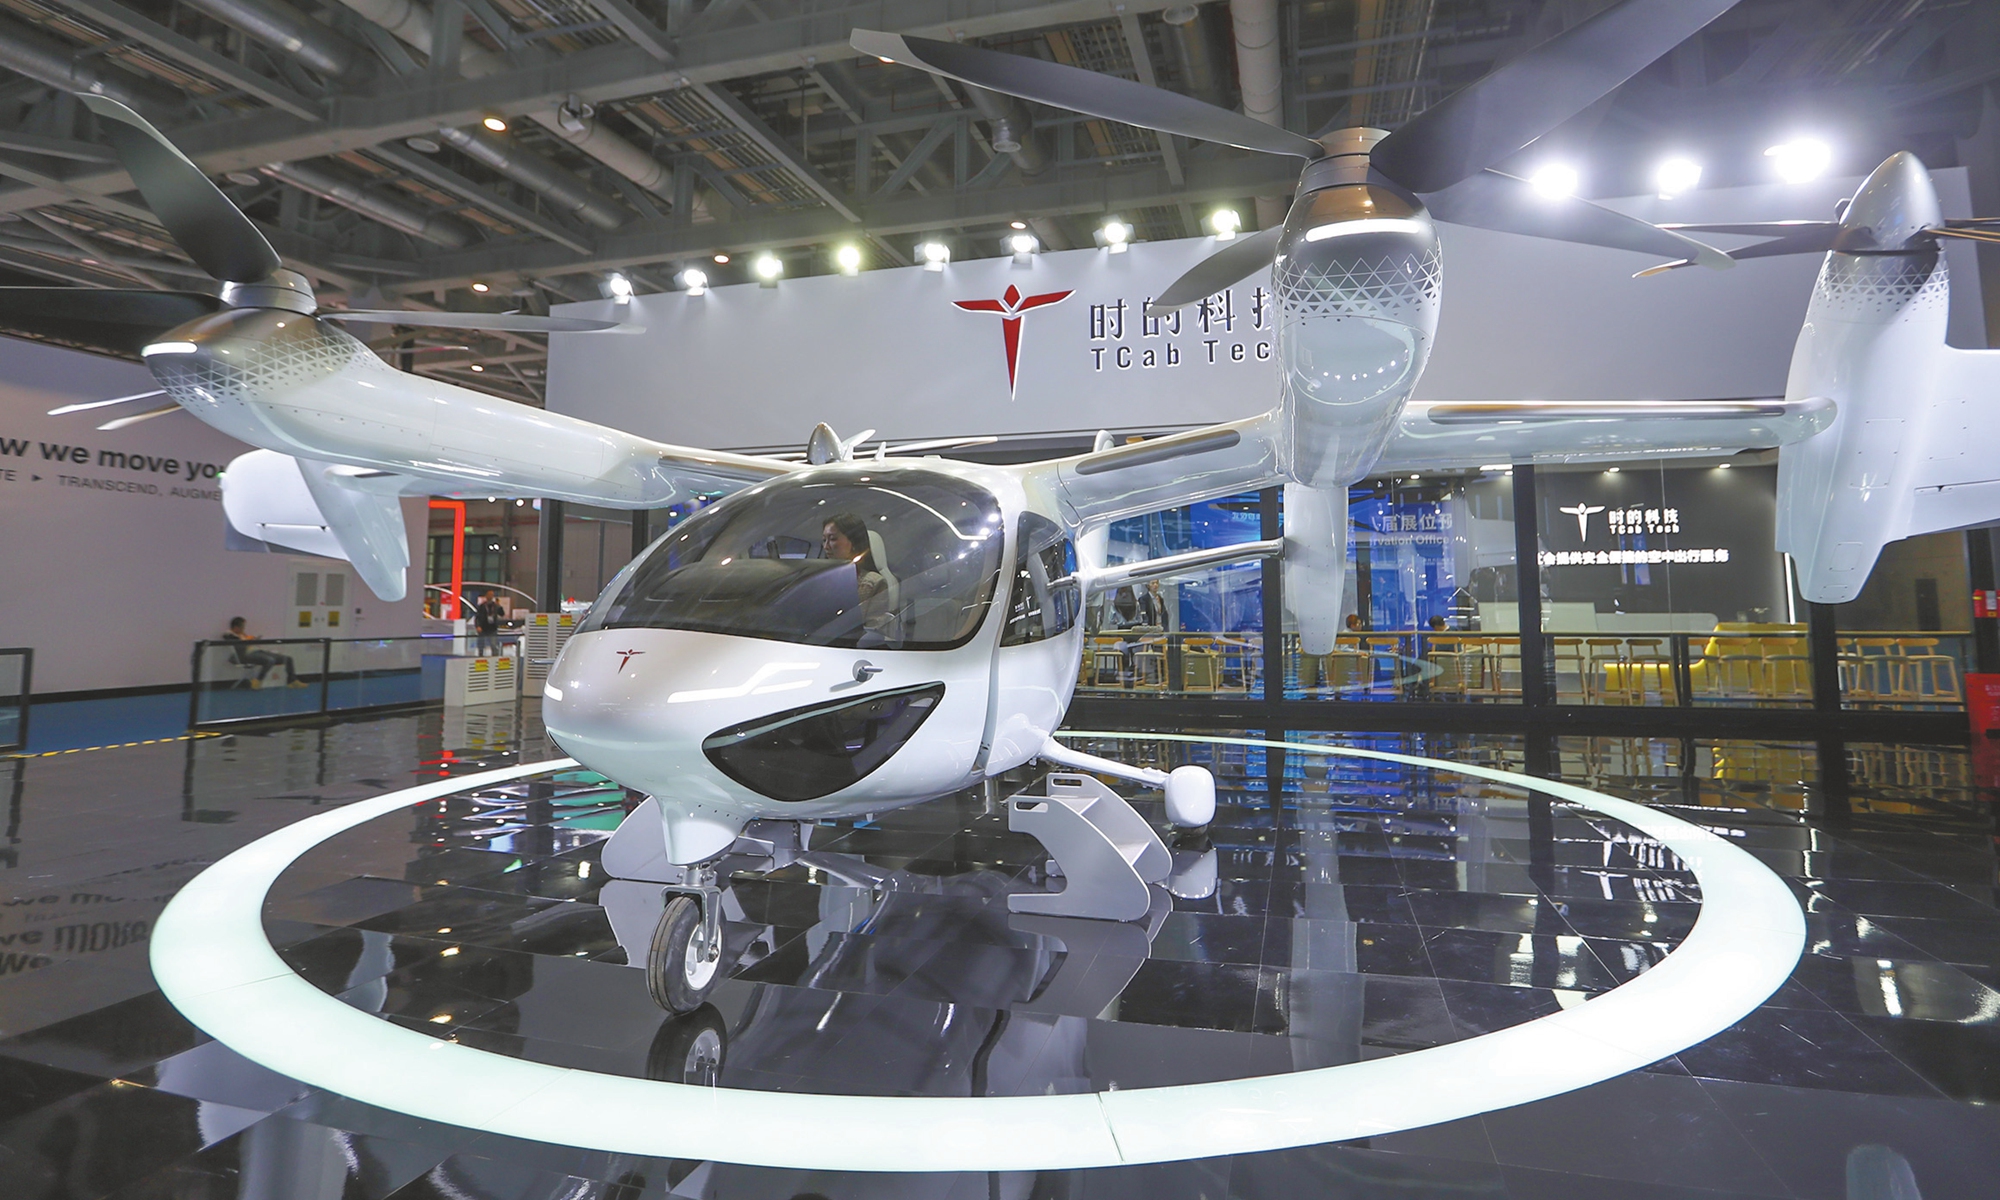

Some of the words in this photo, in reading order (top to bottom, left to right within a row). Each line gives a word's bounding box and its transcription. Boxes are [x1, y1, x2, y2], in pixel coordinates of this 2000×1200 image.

[1090, 342, 1181, 371] TCab
[40, 442, 90, 464] we
[98, 449, 180, 474] move
[186, 460, 225, 482] yo
